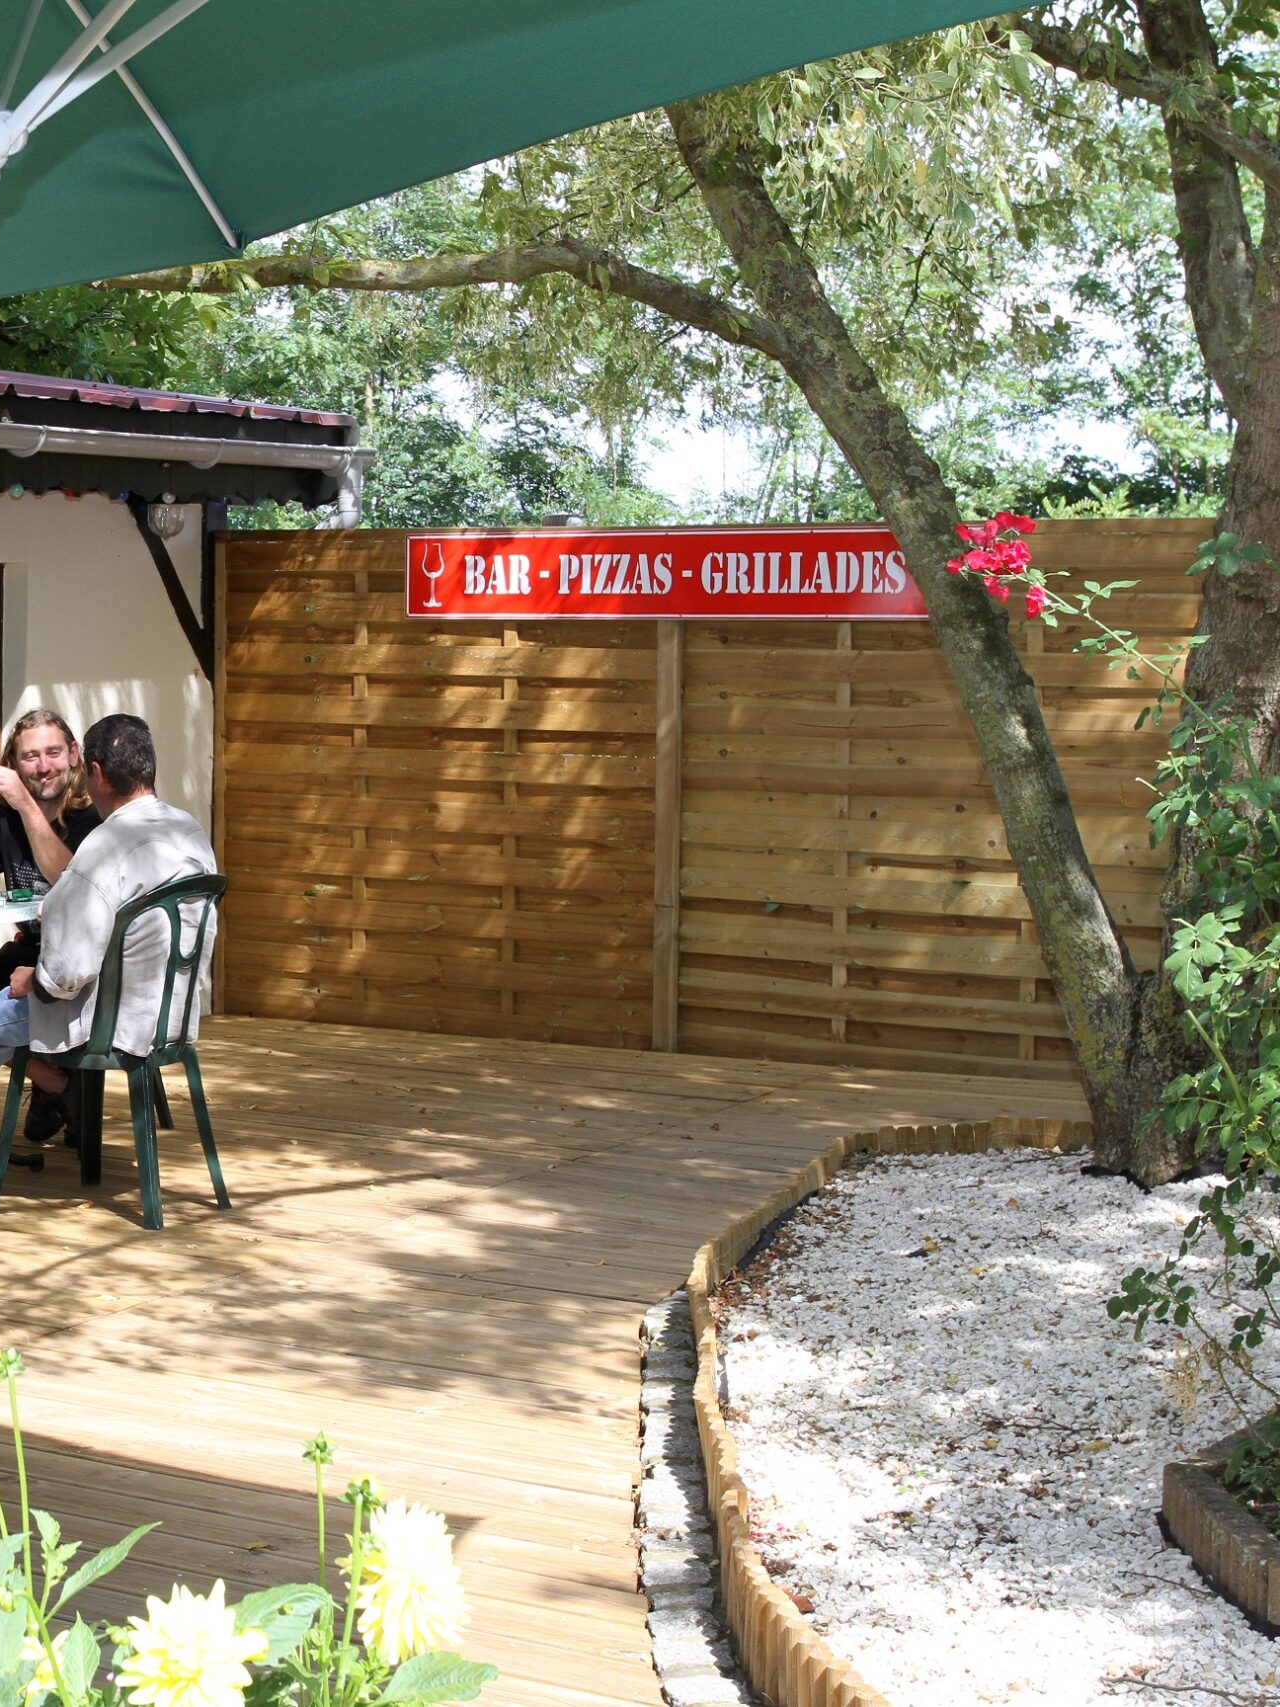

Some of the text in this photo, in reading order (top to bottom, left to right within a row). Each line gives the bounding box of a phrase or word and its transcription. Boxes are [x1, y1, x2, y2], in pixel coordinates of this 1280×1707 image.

[464, 554, 532, 595] BAR
[558, 553, 673, 595] PIZZAS
[701, 550, 907, 595] GRILLADES
